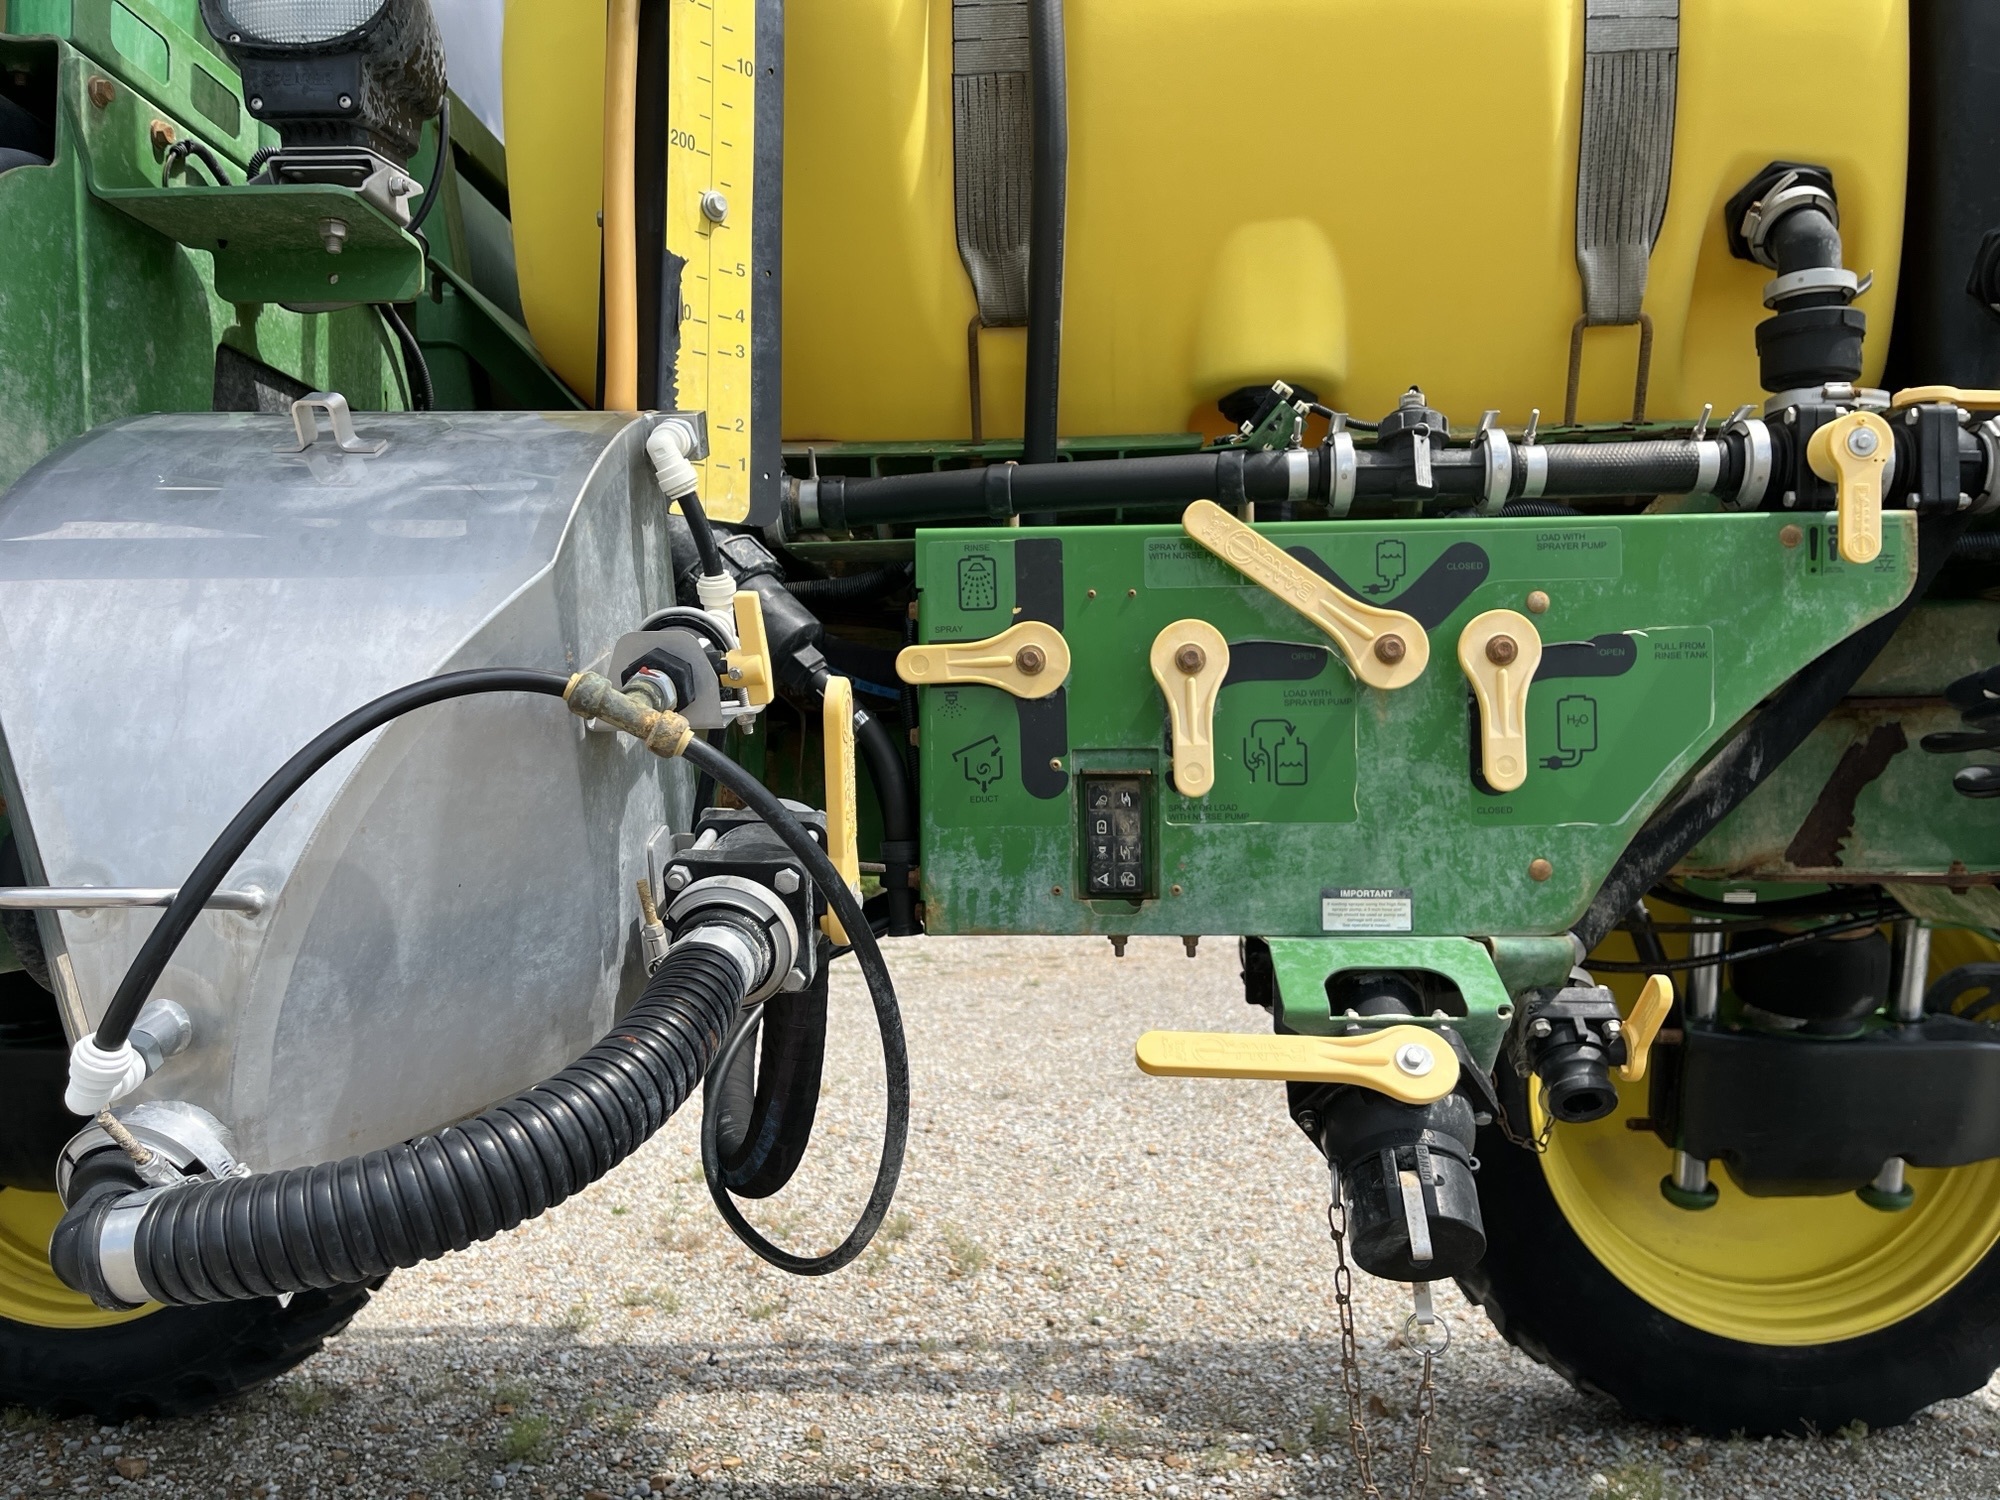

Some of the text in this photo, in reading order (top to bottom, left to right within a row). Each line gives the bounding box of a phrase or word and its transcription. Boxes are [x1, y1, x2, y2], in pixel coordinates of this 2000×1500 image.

[737, 58, 753, 78] 10
[670, 128, 696, 152] 200
[736, 262, 746, 278] 5
[735, 309, 746, 324] 4
[735, 344, 746, 359] 3
[735, 418, 744, 433] 2
[738, 458, 746, 472] 1
[1536, 532, 1586, 542] LOAD WITH
[964, 544, 992, 552] RINSE
[1148, 543, 1178, 552] SPRAY
[1536, 541, 1608, 551] SPRAYER PUMP
[1446, 561, 1484, 570] CLOSED
[934, 625, 964, 634] SPRAY
[1679, 642, 1706, 650] FROM
[1291, 652, 1316, 660] OPEN
[1599, 648, 1626, 656] OPEN
[1654, 650, 1708, 660] RINSE TANK
[1283, 688, 1332, 698] LOAD WITH
[1284, 697, 1352, 706] SPRAYER PUMP
[970, 795, 999, 804] EDUCT
[1168, 804, 1238, 812] SPRAY OR LOAD
[1476, 806, 1513, 815] CLOSED
[1168, 812, 1250, 821] WITH NURSE PUMP
[1340, 889, 1394, 898] IMPORTANT
[1417, 1148, 1432, 1182] BANJO
